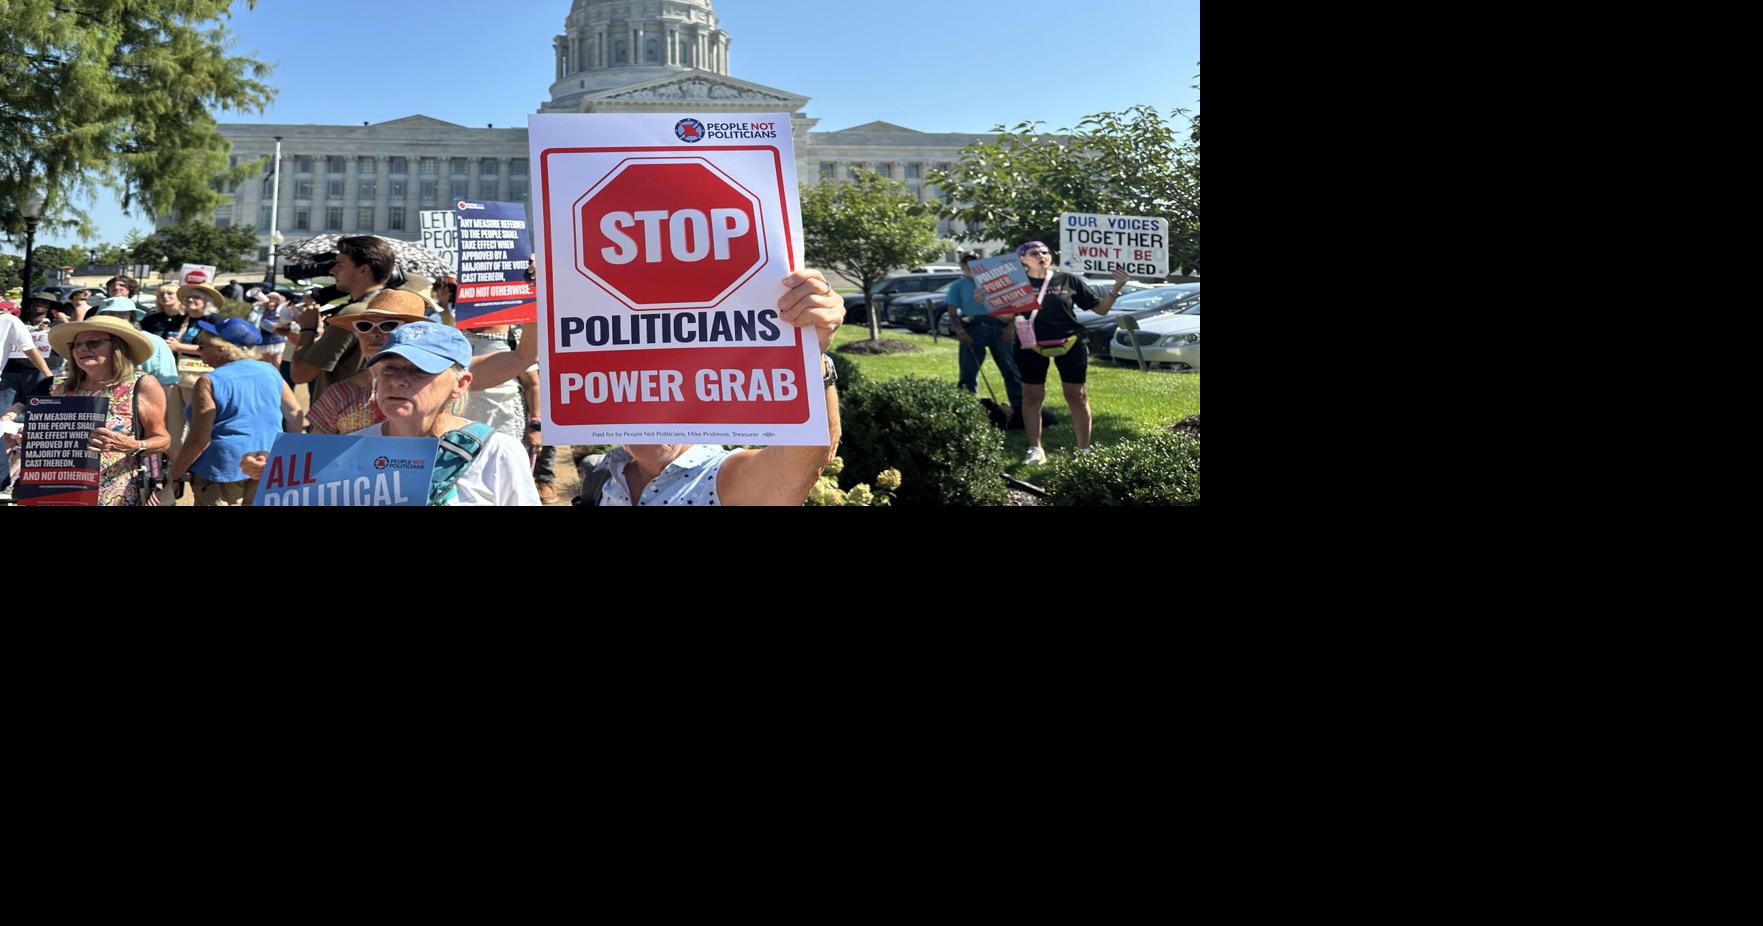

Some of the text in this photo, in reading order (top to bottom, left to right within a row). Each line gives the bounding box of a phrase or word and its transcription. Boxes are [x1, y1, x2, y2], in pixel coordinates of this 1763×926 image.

[708, 130, 776, 139] POLITICIANS
[422, 212, 448, 229] LET
[1068, 216, 1159, 231] OUR VOICES
[424, 230, 458, 248] PEOP
[461, 230, 519, 239] TO THE PEOPLE SHALL
[600, 208, 750, 264] STOP
[1066, 228, 1163, 248] TOGETHER
[462, 240, 514, 249] TAKE EFFECT WHEN
[462, 250, 493, 260] APPROVED
[494, 250, 502, 260] BY
[502, 250, 507, 260] A
[1134, 250, 1152, 261] BE
[462, 261, 493, 271] MAJORITY
[494, 261, 501, 270] OF
[502, 261, 512, 270] THE
[1084, 260, 1156, 275] SILENCED
[462, 273, 476, 283] CAST
[976, 262, 1018, 283] POLITICAL
[984, 277, 1012, 292] POWER
[459, 288, 475, 298] AND
[476, 287, 490, 297] NOT
[560, 368, 798, 404] POWER GRAB
[44, 412, 76, 420] MEASURE
[76, 422, 95, 430] SHALL
[26, 441, 62, 449] APPROVED
[26, 450, 61, 458] MAJORITY
[23, 472, 40, 480] AND
[41, 472, 57, 480] NOT
[265, 452, 316, 489] ALL
